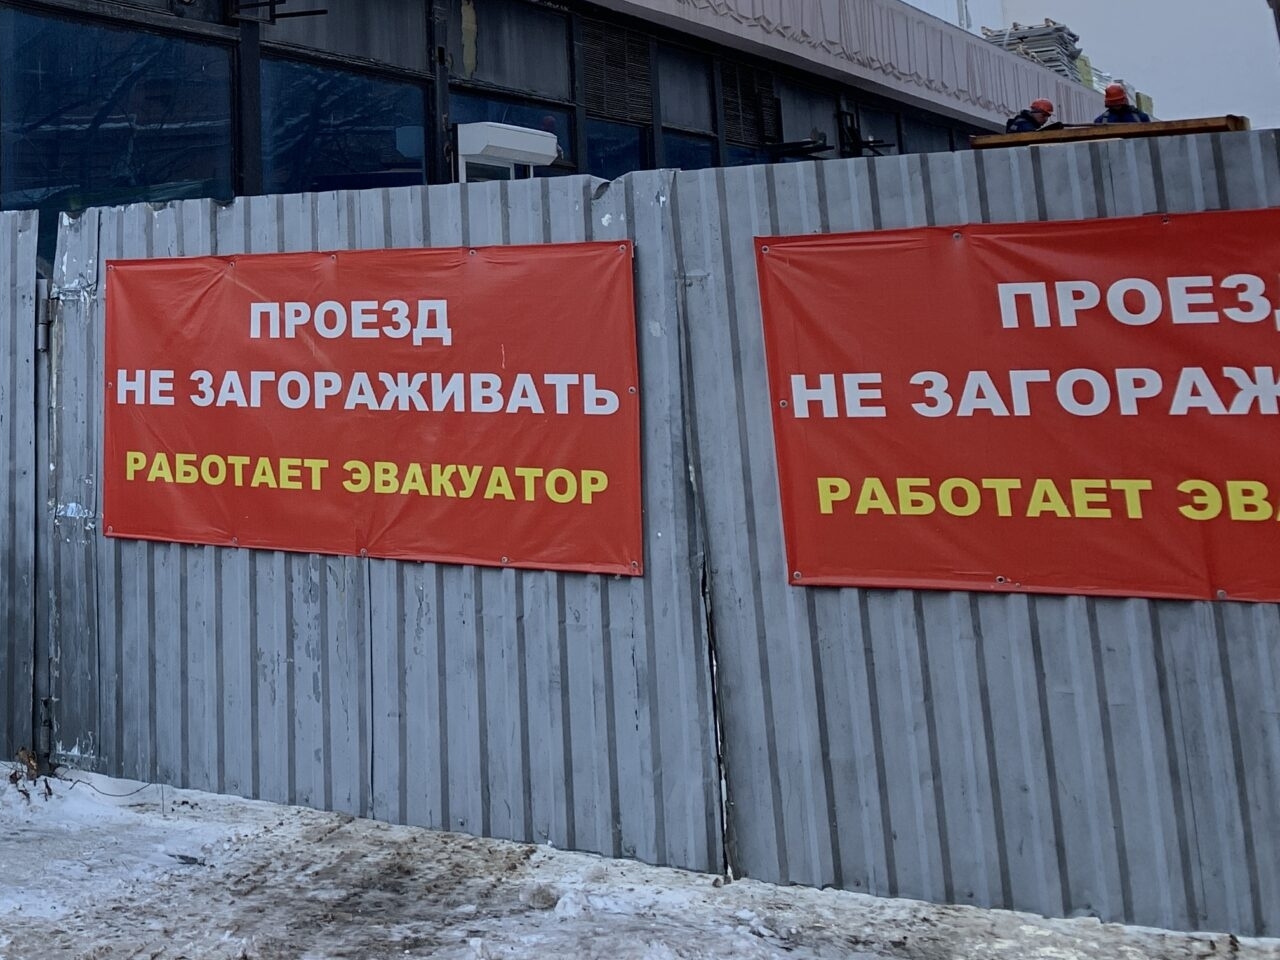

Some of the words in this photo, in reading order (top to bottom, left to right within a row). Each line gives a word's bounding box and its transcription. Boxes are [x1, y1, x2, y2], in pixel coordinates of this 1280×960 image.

[250, 300, 452, 346] ПРОЕЗД
[998, 274, 1280, 331] ПРОЕЗ
[117, 369, 175, 405] НЕ
[190, 370, 620, 415] ЗАГОРАЖИВАТЬ
[791, 373, 887, 418] НЕ
[126, 451, 329, 490] РАБОТАЕТ
[343, 460, 609, 504] ЭВАКУАТОР
[817, 478, 1153, 519] РАБОТАЕТ
[1177, 480, 1280, 521] ЭВ
